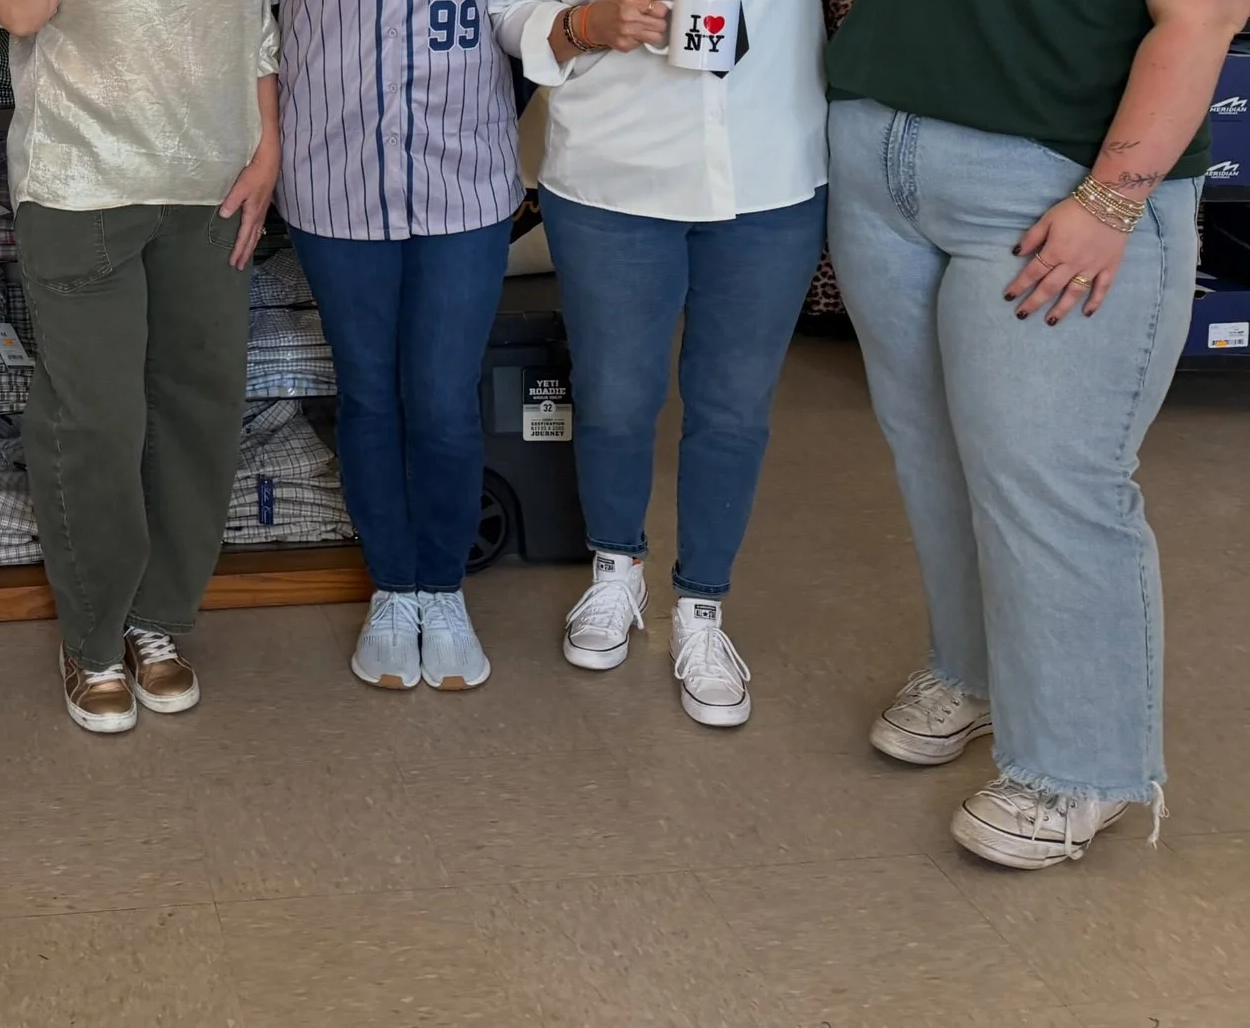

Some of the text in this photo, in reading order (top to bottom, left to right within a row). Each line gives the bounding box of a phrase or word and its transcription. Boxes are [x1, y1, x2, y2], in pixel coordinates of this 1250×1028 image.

[689, 14, 701, 33] I
[684, 32, 725, 53] NY
[536, 379, 559, 387] YETI
[529, 387, 566, 396] ROADIE
[543, 403, 553, 412] 32
